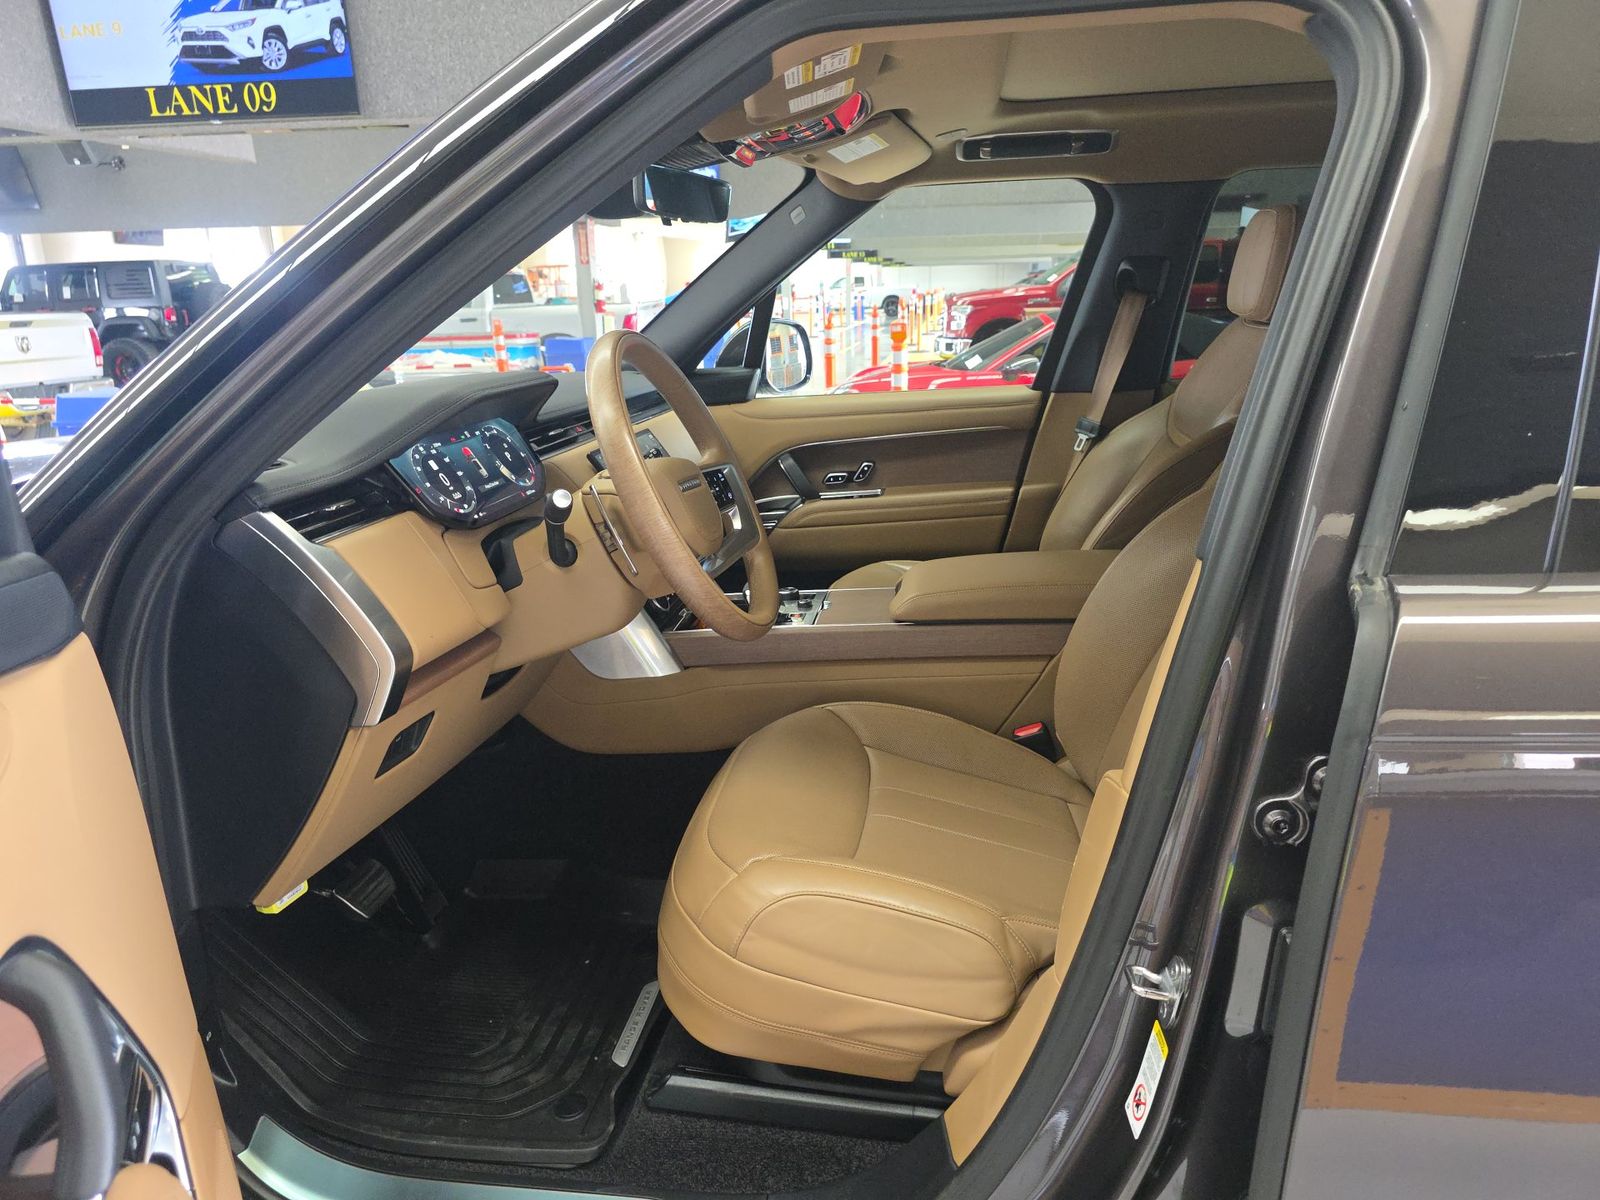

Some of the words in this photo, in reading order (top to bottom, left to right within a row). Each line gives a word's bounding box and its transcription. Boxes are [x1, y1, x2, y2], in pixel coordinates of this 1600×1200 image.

[59, 21, 104, 40] LANE
[112, 19, 123, 36] 9
[145, 84, 238, 117] LANE
[243, 81, 277, 113] 09
[438, 472, 451, 487] 0
